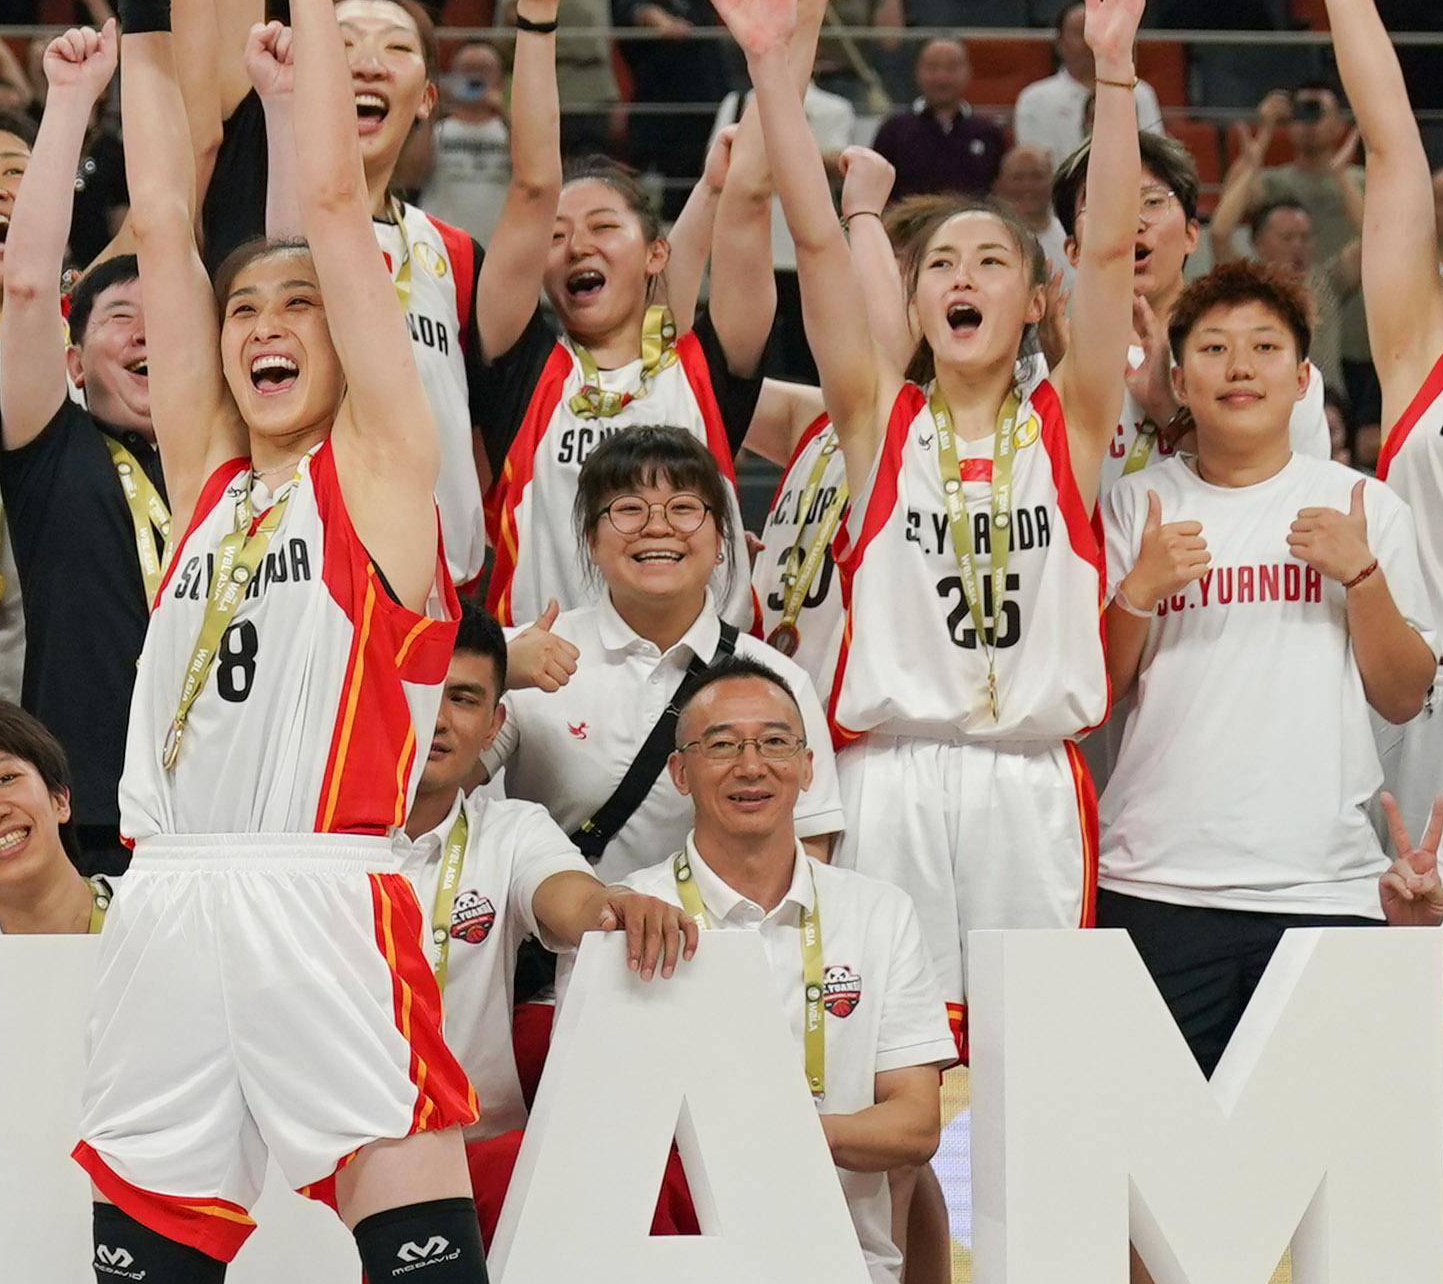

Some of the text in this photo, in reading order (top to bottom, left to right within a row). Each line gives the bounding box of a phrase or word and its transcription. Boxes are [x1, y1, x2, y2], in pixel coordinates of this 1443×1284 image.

[936, 573, 1021, 650] 25
[182, 648, 209, 703] WBL ASIA
[216, 619, 259, 703] 8
[442, 843, 463, 891] WBL ASIA
